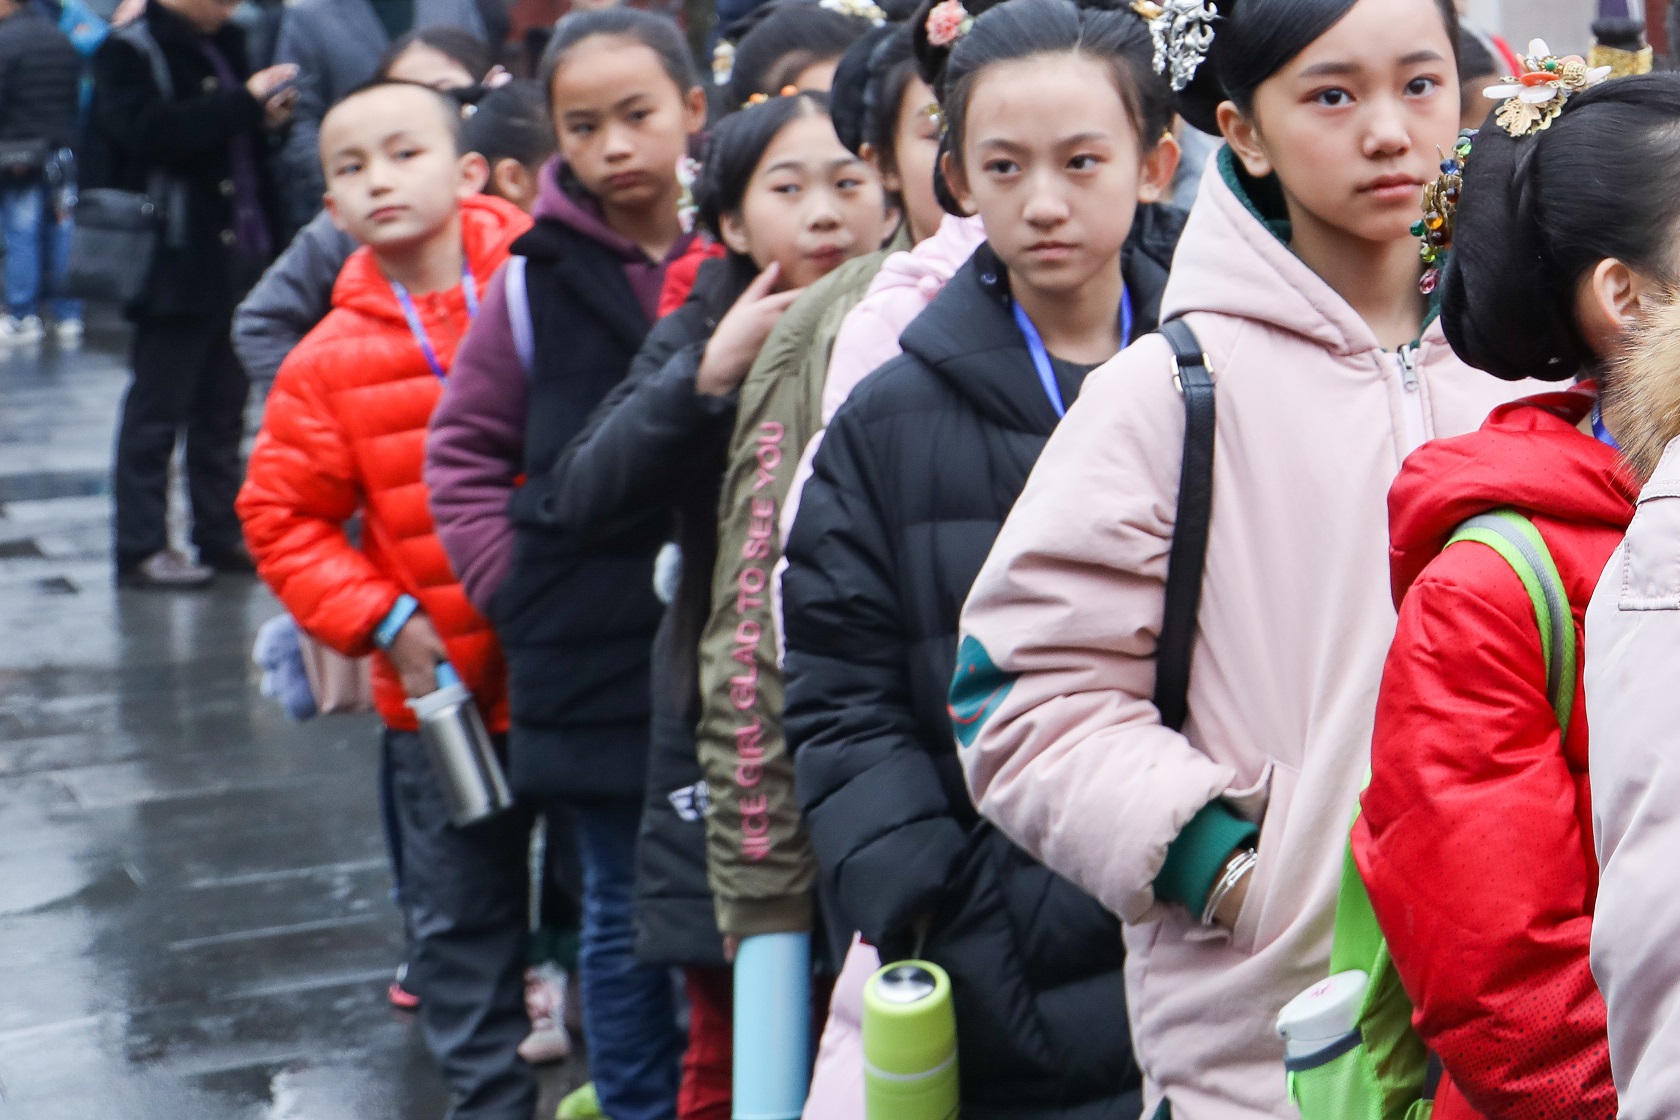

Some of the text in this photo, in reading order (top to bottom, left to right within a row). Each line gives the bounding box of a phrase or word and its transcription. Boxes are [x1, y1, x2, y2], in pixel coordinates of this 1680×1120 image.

[752, 421, 785, 490] YOU
[742, 496, 775, 560] SEE
[737, 567, 766, 614] TO
[729, 619, 763, 710] GLAD
[735, 716, 765, 787] GIRL
